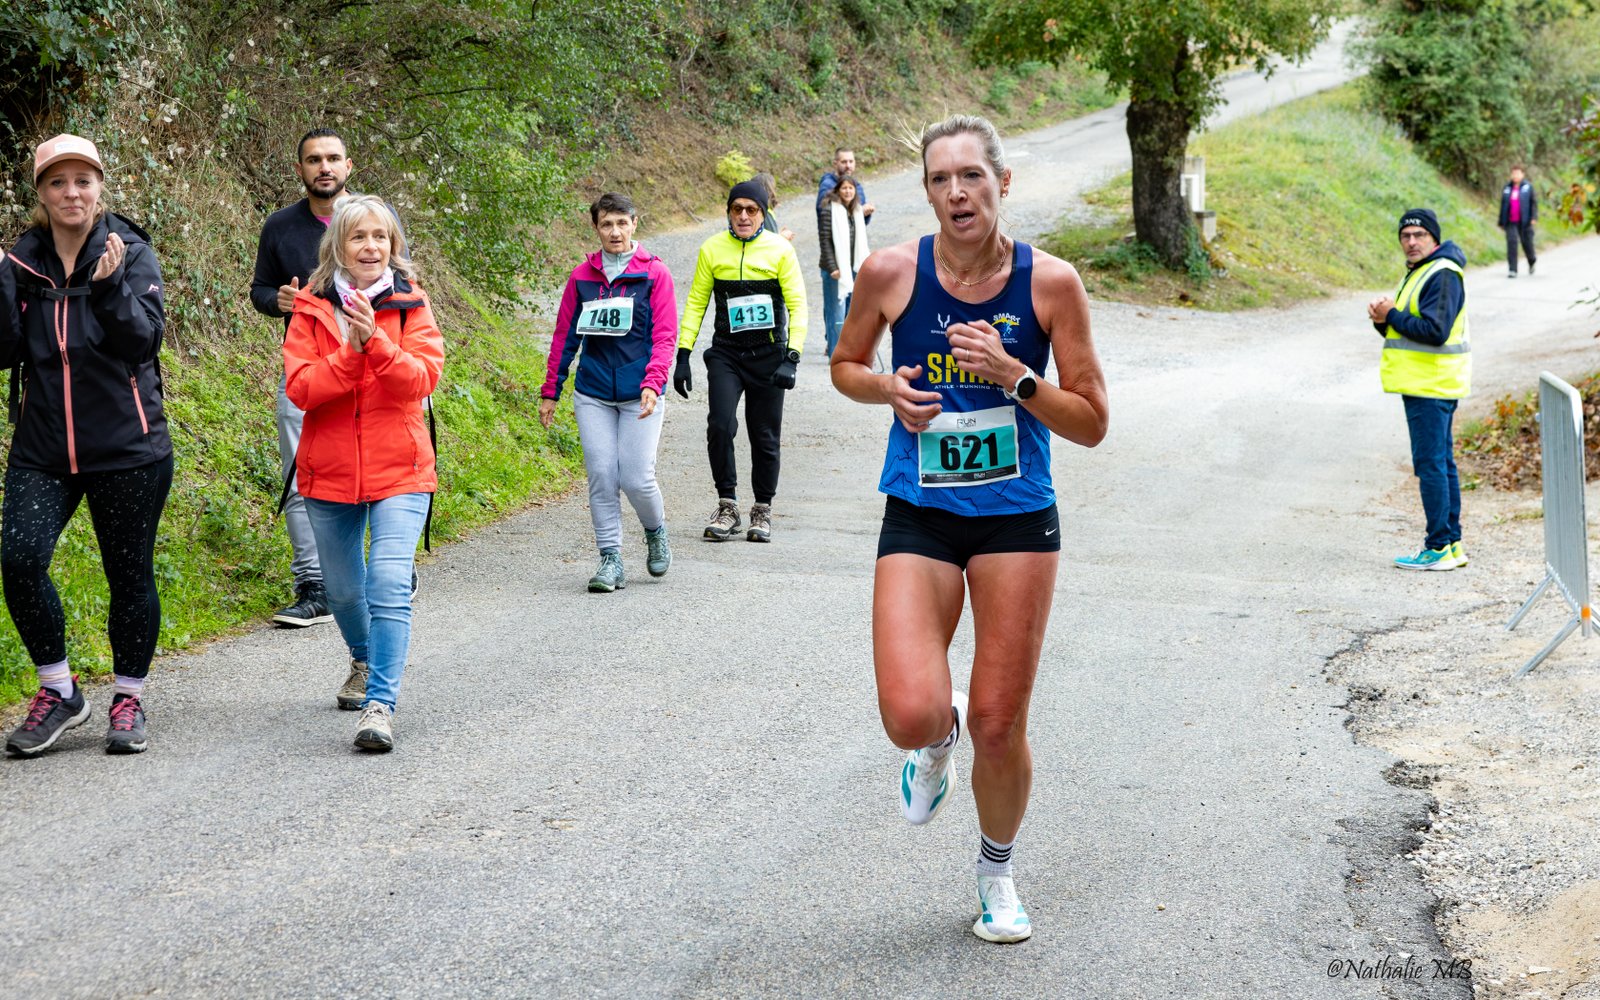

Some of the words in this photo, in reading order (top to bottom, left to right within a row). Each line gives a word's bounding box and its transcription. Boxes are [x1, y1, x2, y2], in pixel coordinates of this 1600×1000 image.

[735, 306, 767, 323] 413
[993, 313, 1020, 323] SMART
[940, 432, 998, 471] 621
